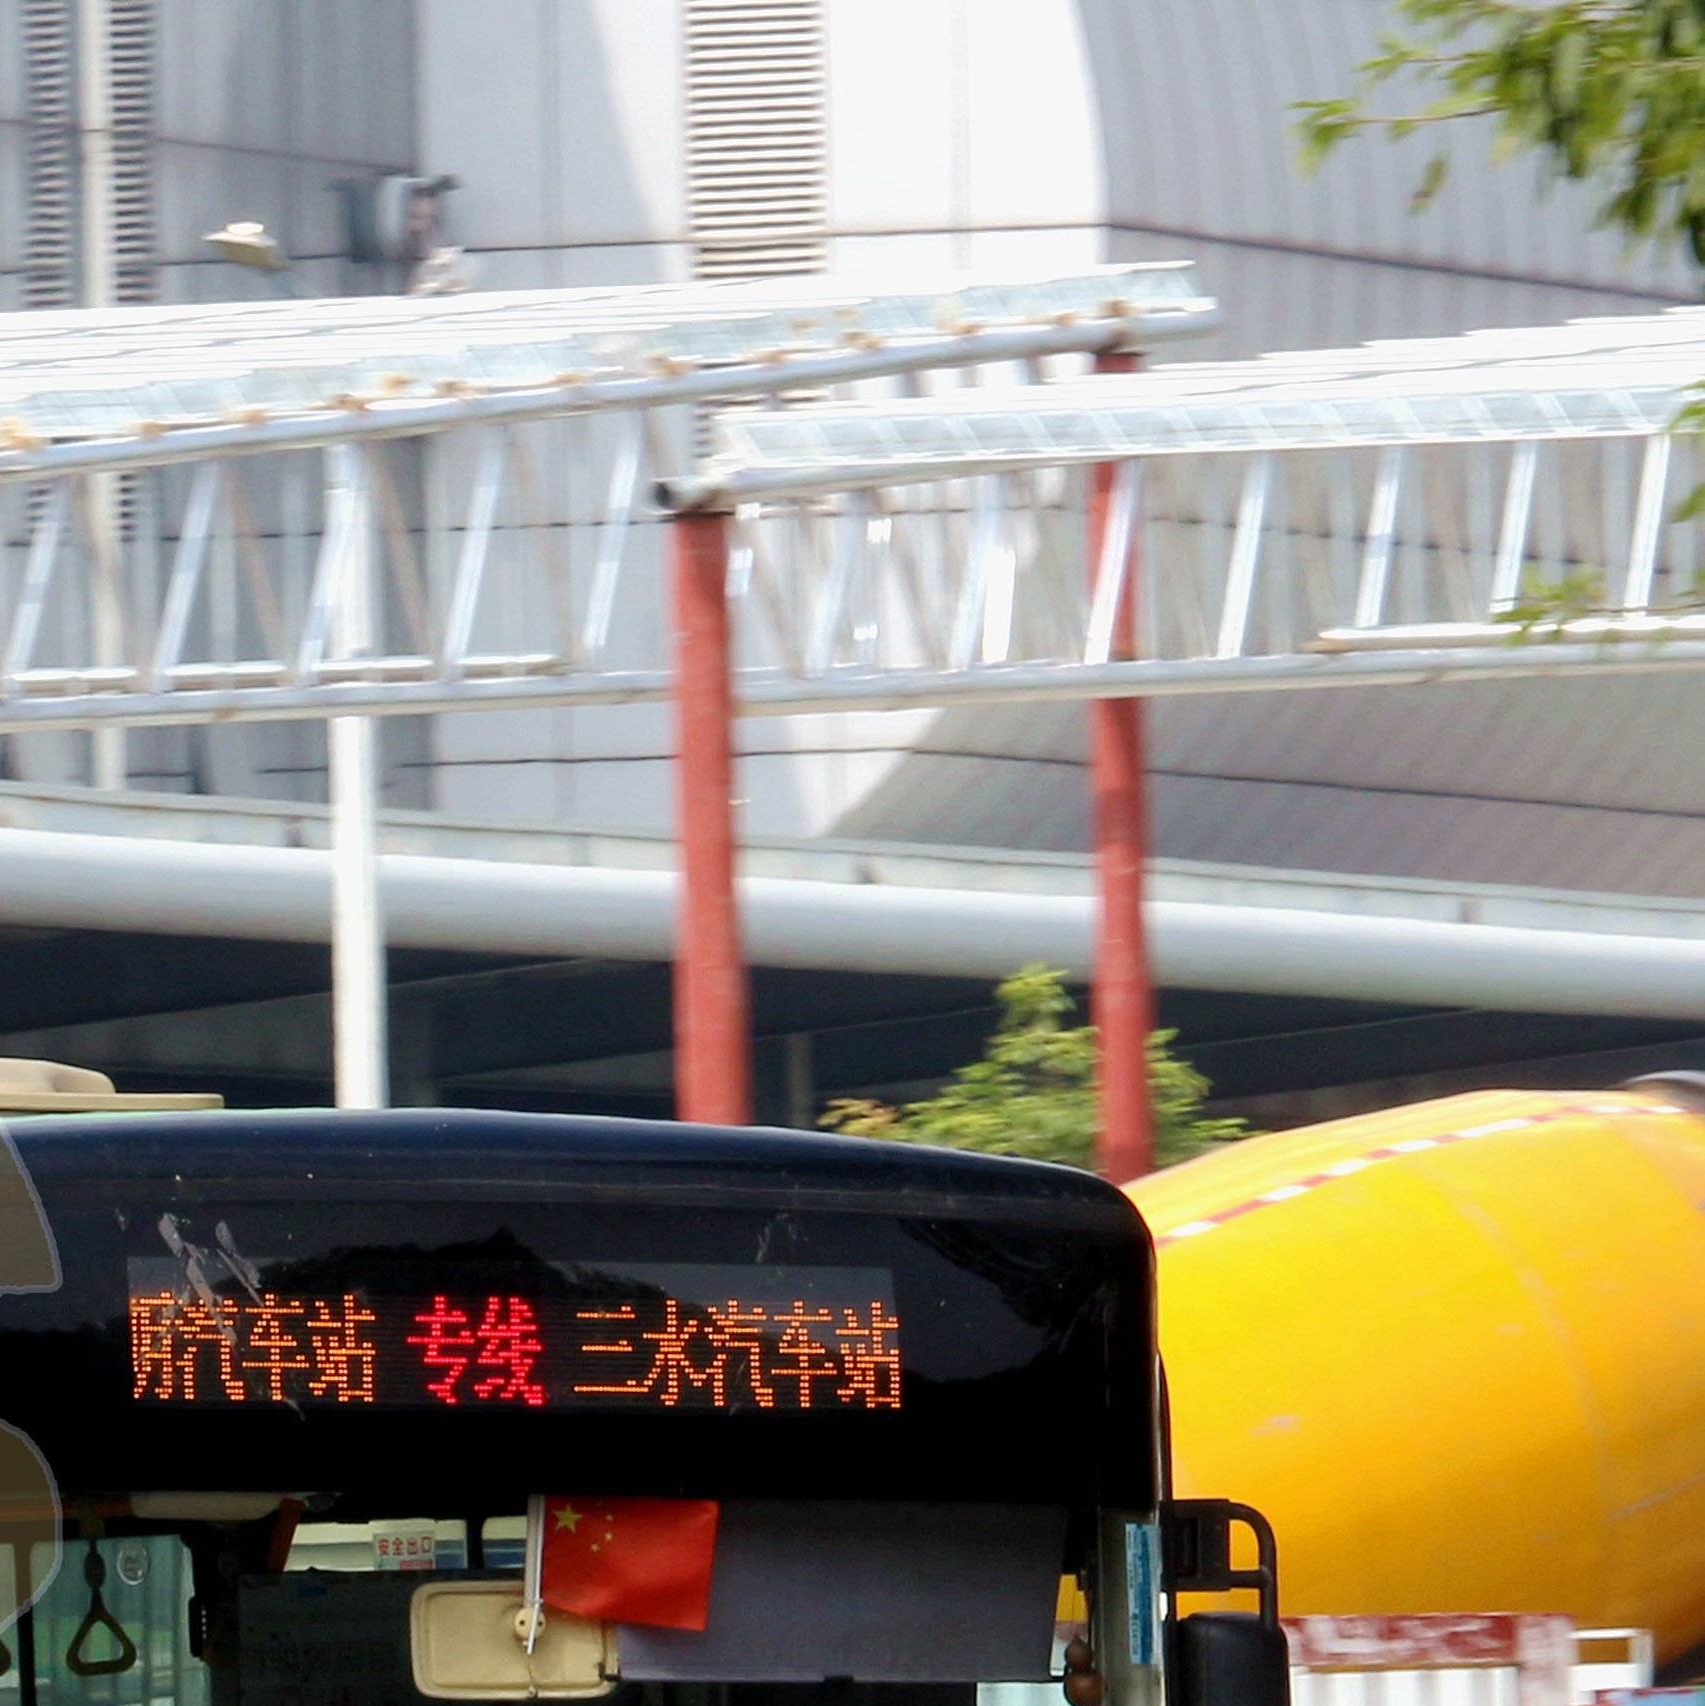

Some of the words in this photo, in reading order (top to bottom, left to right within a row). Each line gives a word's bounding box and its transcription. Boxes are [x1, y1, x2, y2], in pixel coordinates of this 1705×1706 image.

[406, 1294, 543, 1405] 专线
[574, 1299, 902, 1408] 三水汽车站
[378, 1535, 433, 1557] 安全出口
